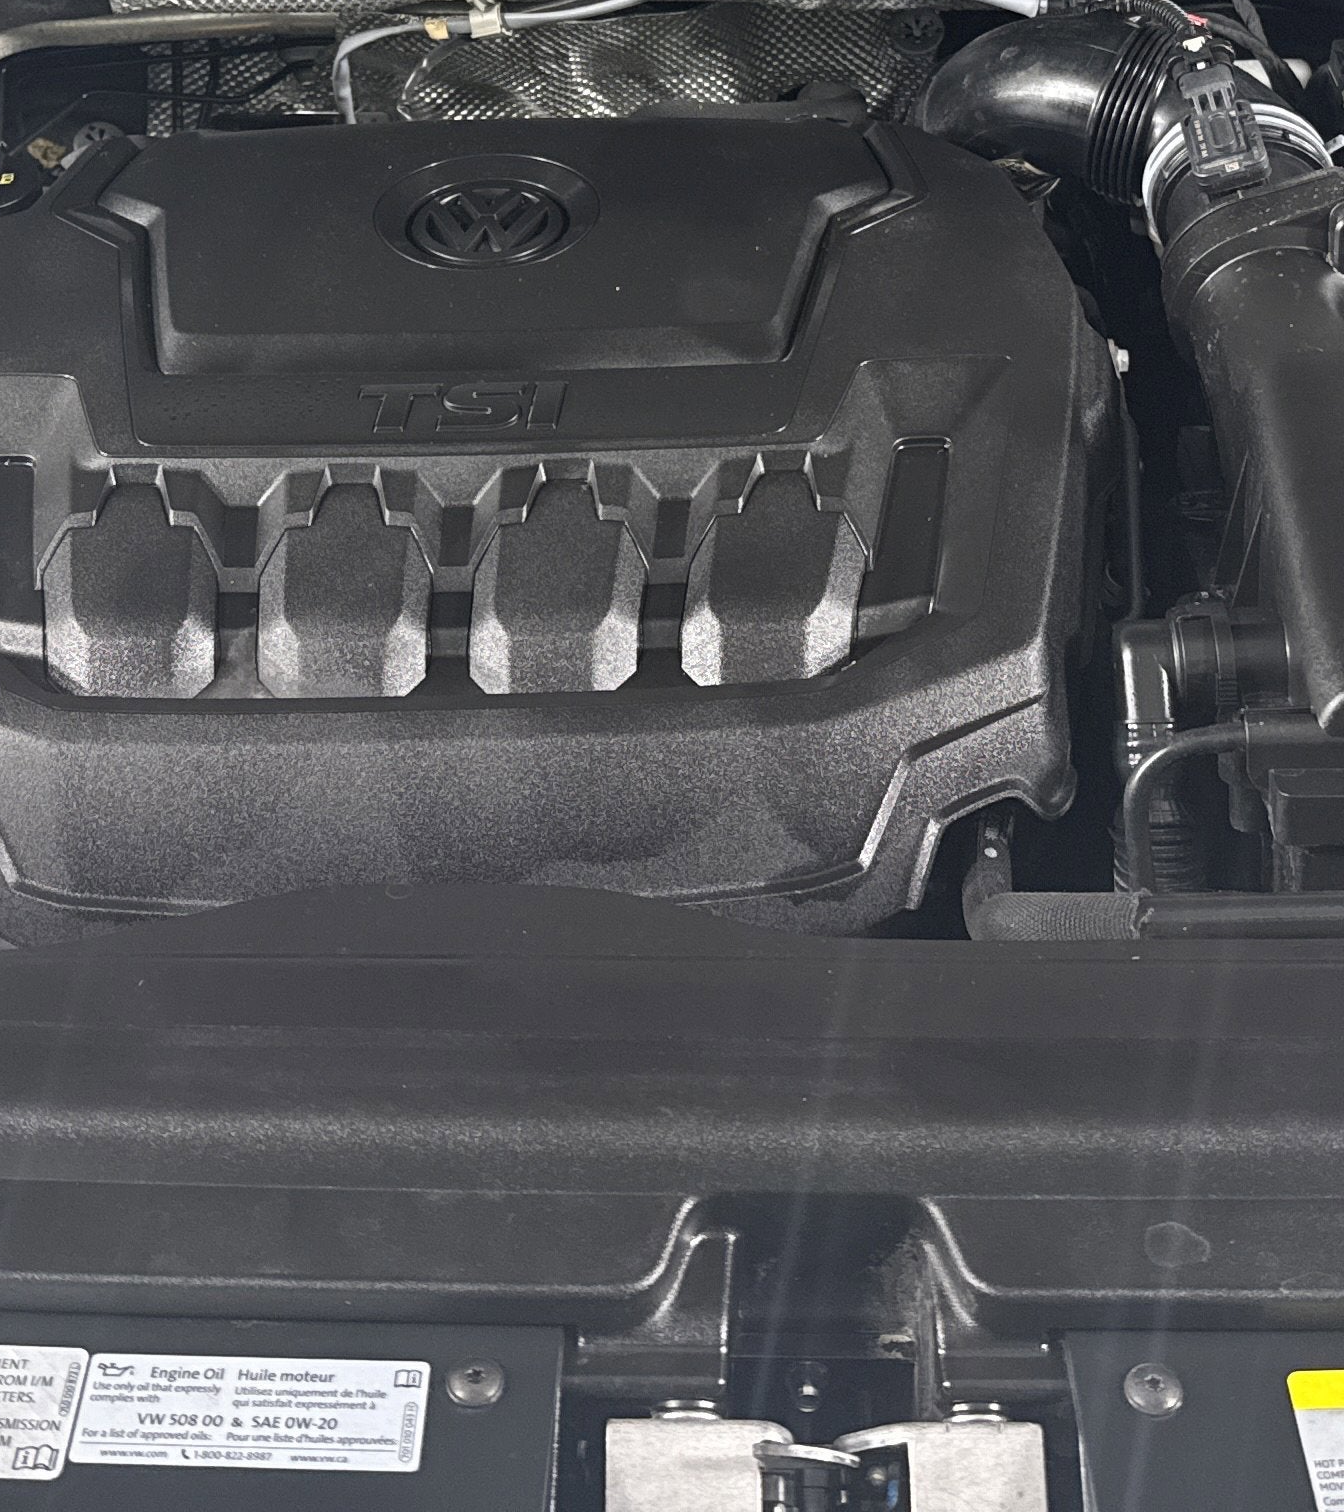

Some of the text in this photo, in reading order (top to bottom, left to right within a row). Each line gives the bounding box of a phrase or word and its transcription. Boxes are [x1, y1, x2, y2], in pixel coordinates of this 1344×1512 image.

[359, 382, 569, 433] TSI
[150, 1366, 225, 1382] Engine Oil
[238, 1368, 335, 1383] Huile moteur
[93, 1381, 222, 1396] Use only oil that expressly
[235, 1386, 273, 1397] Utilisez
[275, 1388, 338, 1400] uniquement
[340, 1389, 353, 1398] de
[89, 1393, 161, 1404] complies with
[232, 1399, 366, 1411] qui satisfait expressément
[137, 1412, 339, 1430] VW 508 00 & SAE 0W-20
[82, 1428, 98, 1437] For
[110, 1428, 125, 1438] list
[127, 1429, 140, 1438] of
[141, 1430, 189, 1441] approved
[226, 1432, 249, 1442] Pour
[251, 1434, 271, 1442] une
[273, 1433, 294, 1443] liste
[1314, 1459, 1336, 1468] HOT
